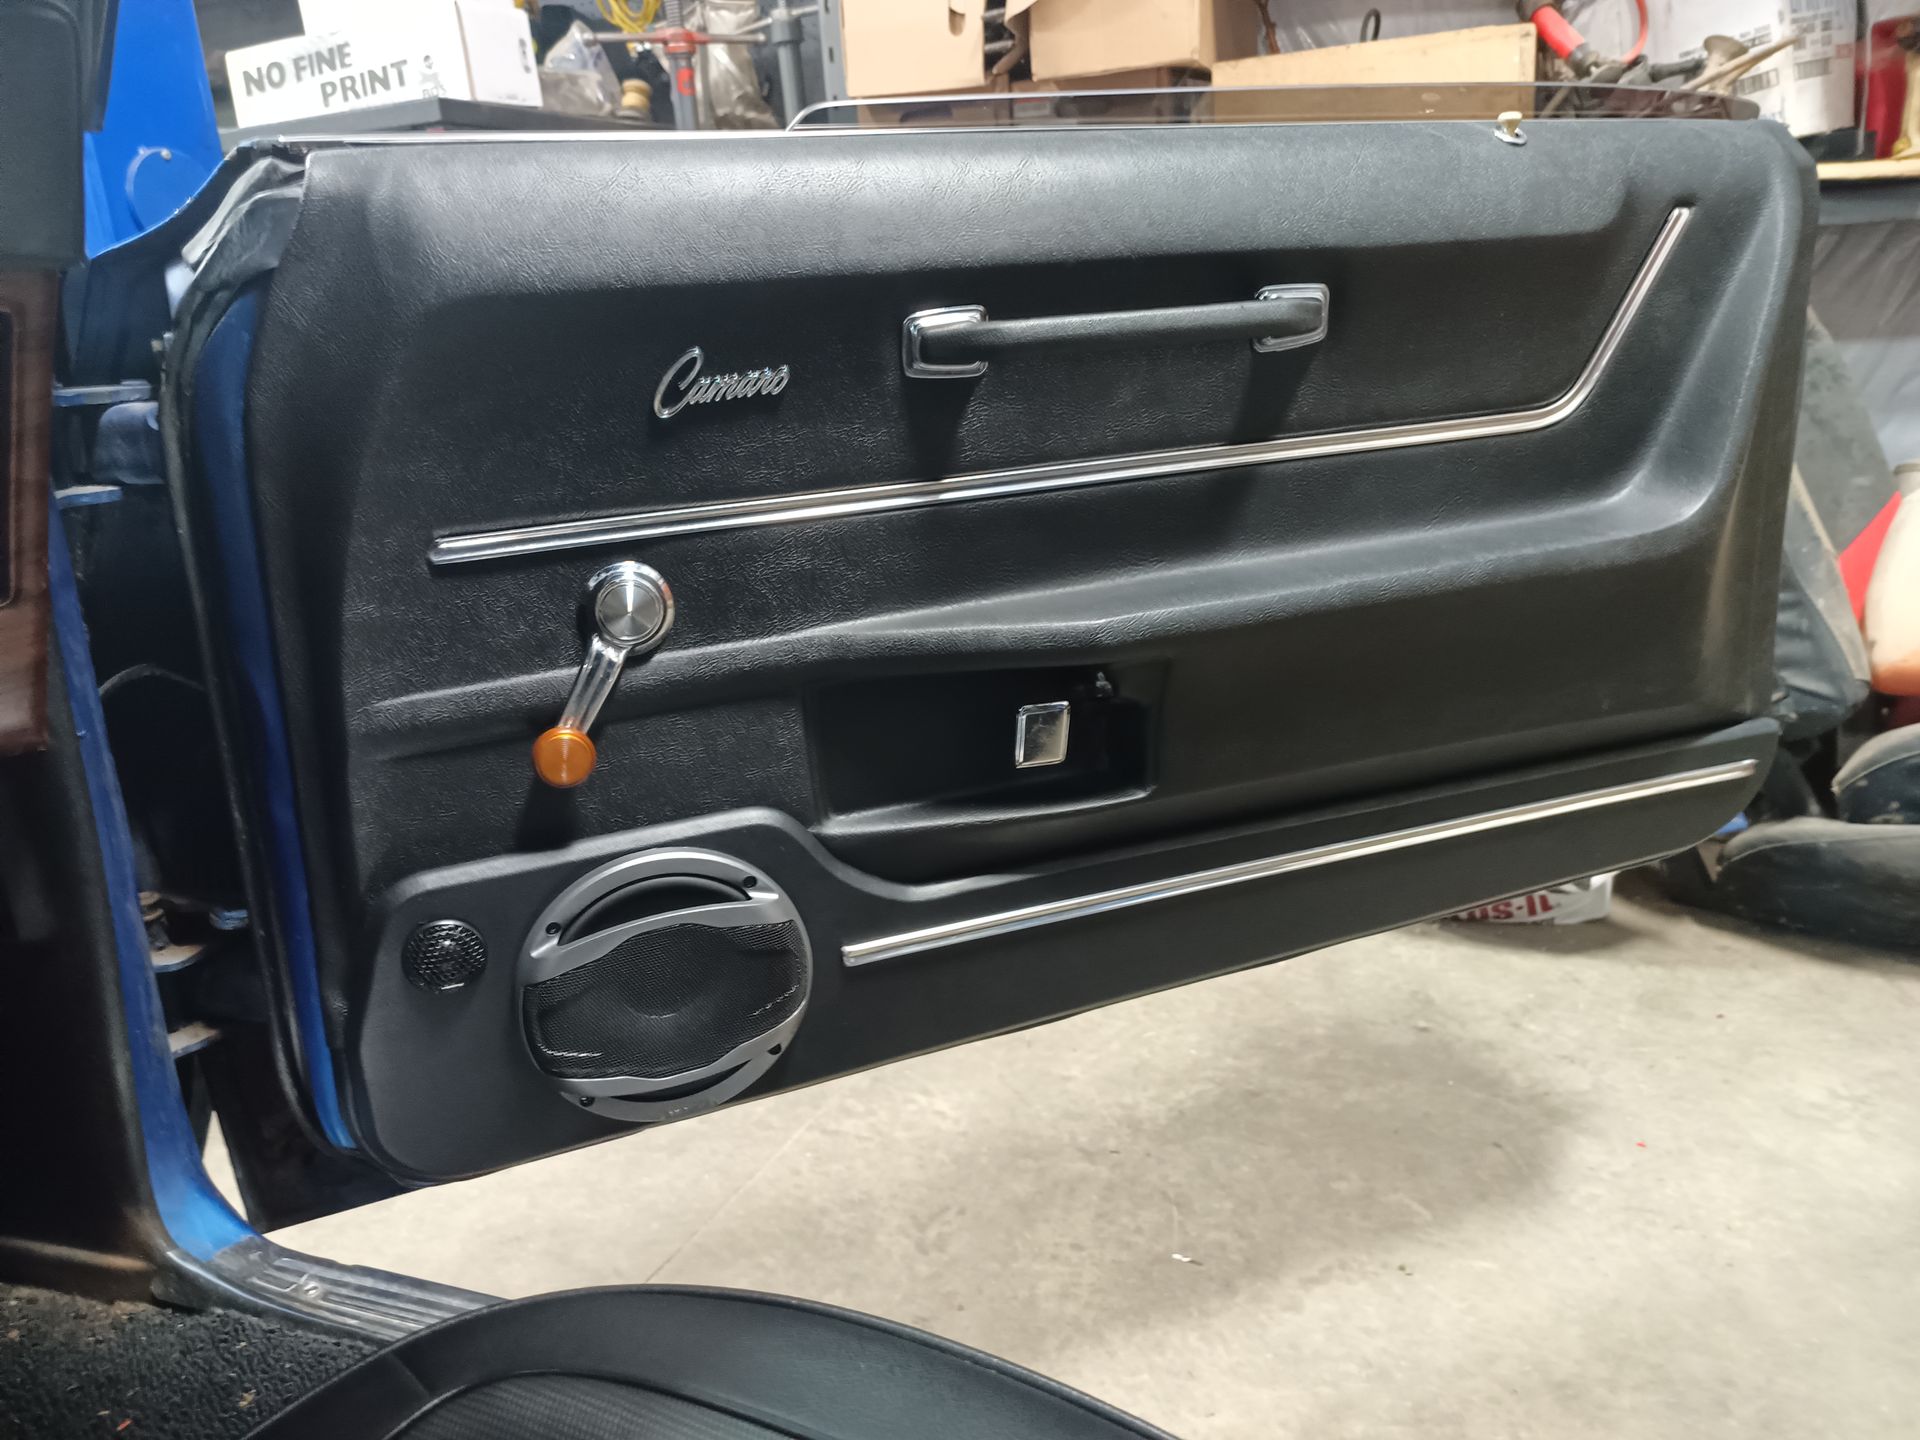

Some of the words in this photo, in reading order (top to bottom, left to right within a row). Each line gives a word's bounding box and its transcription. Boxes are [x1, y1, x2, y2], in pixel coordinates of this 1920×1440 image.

[243, 62, 286, 97] NO
[293, 42, 352, 83] FINE
[320, 59, 408, 108] PRINT
[653, 346, 791, 419] Camaro
